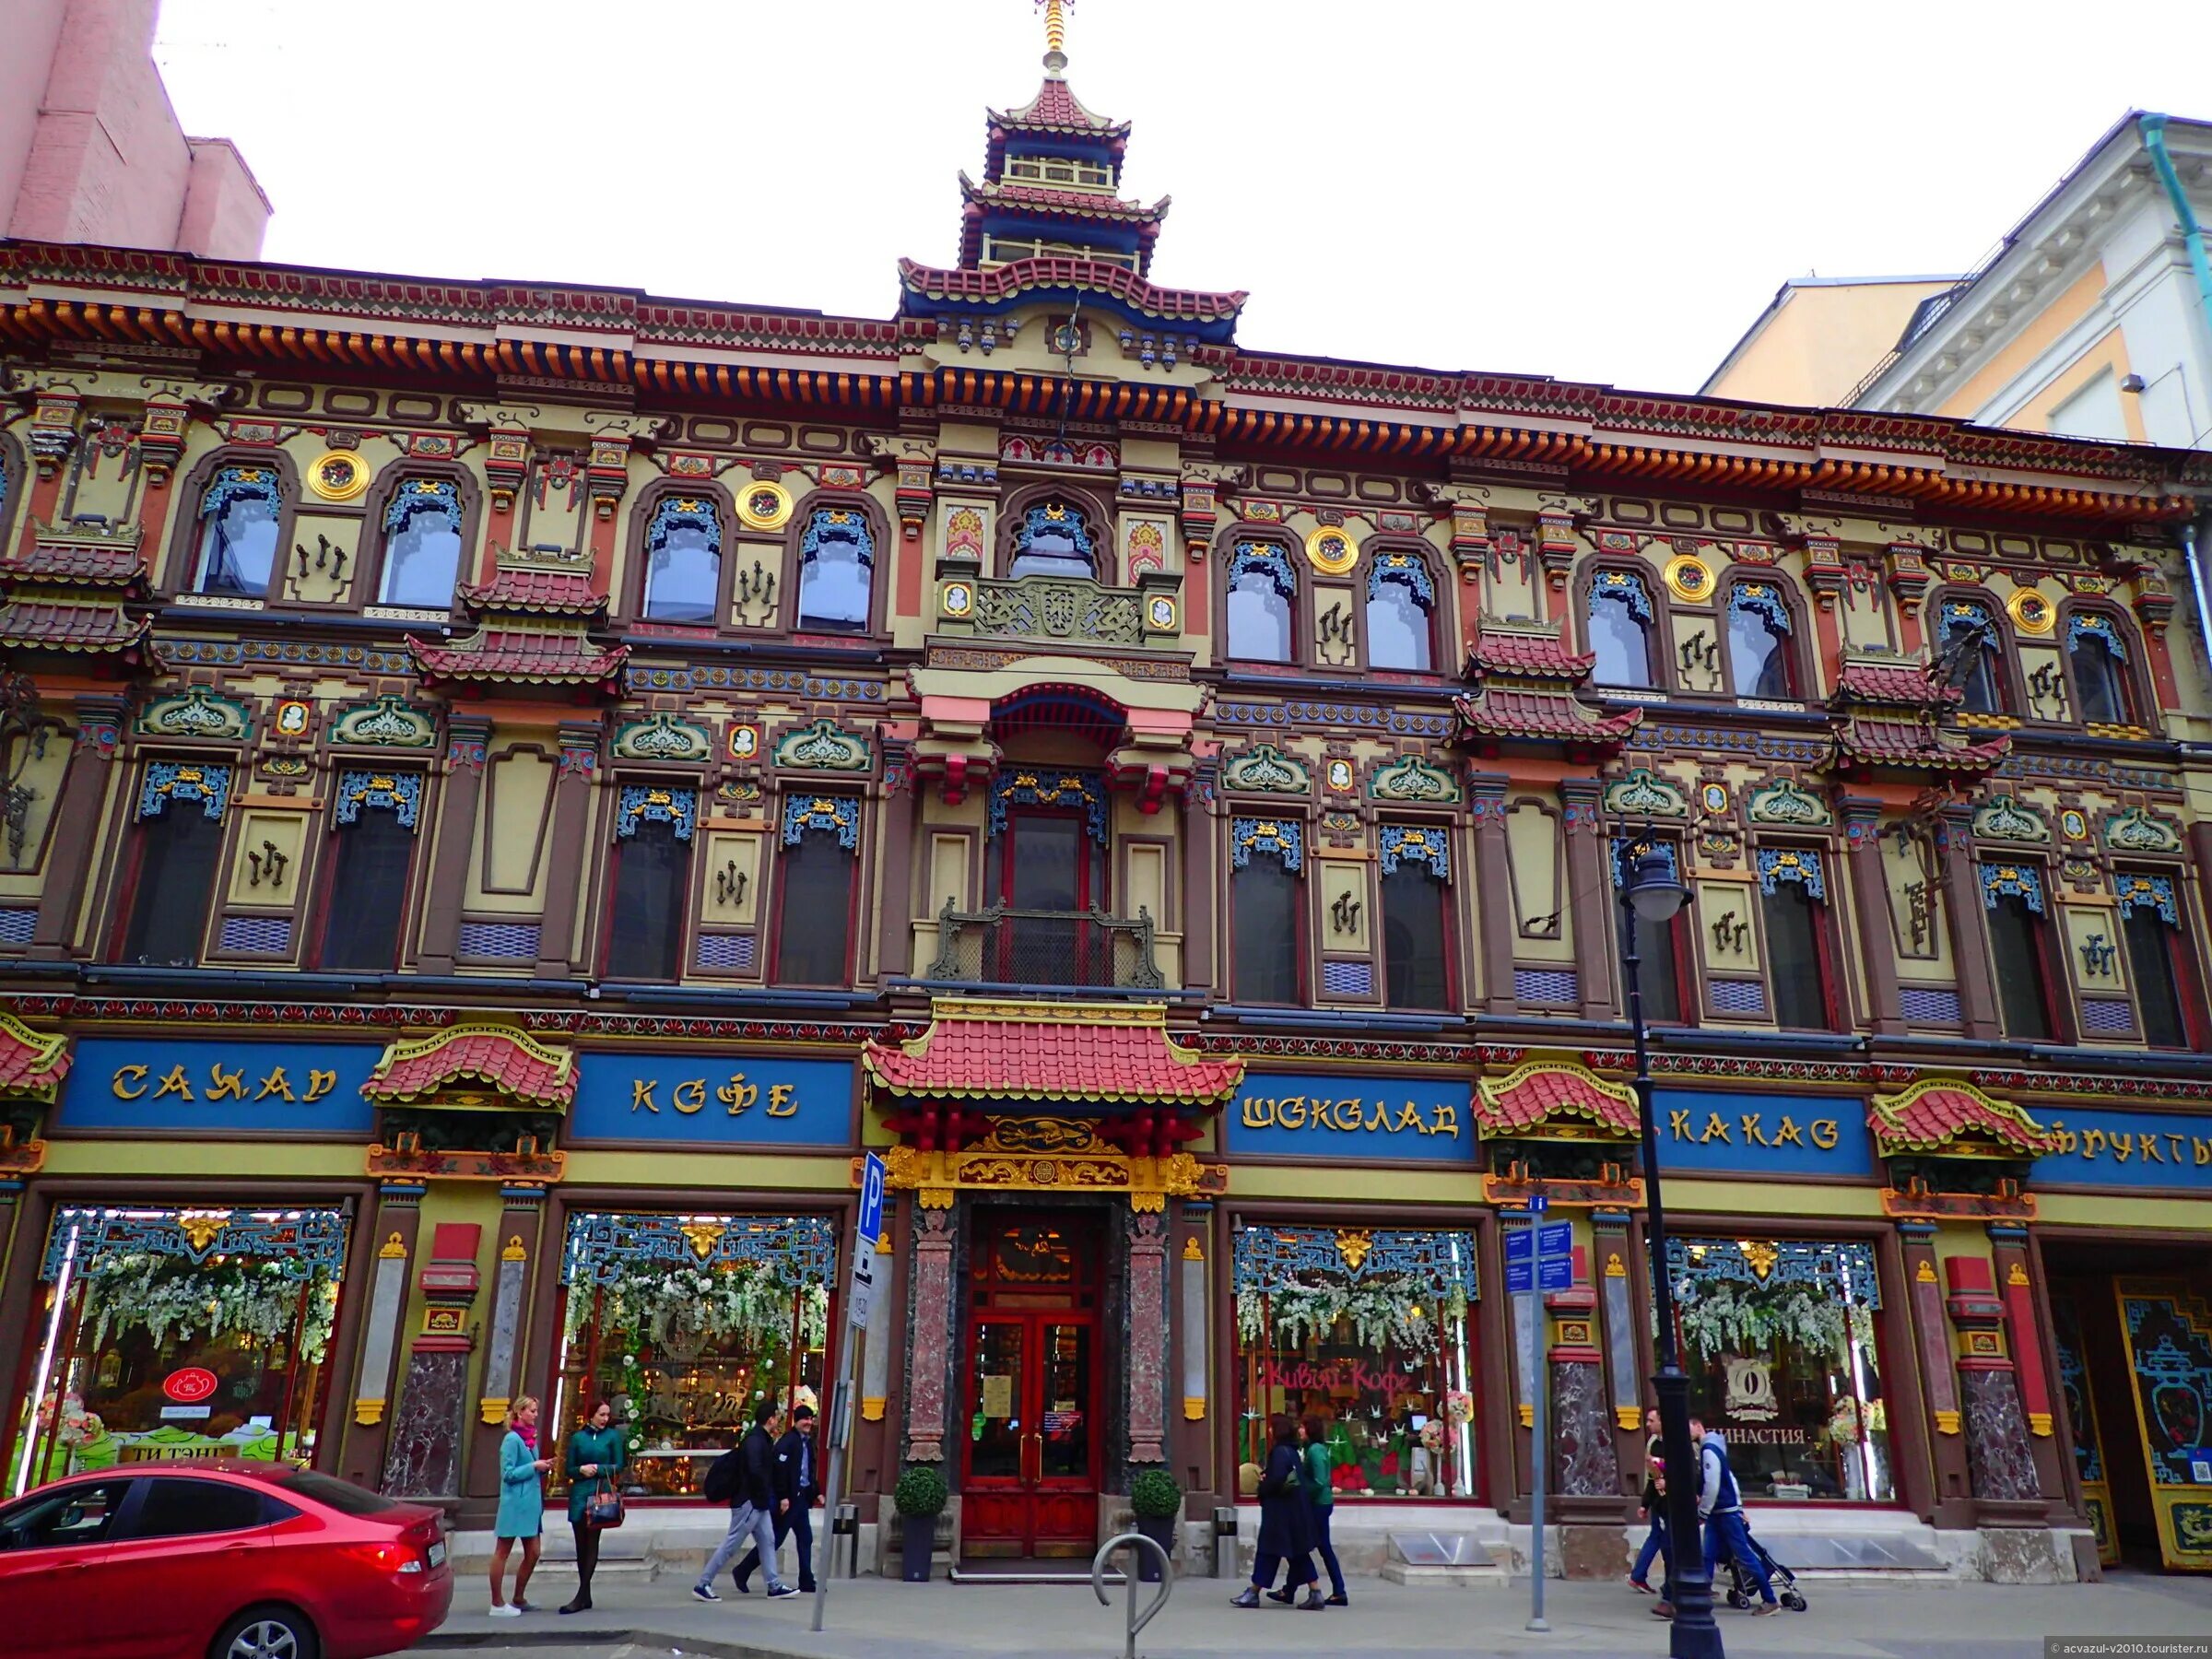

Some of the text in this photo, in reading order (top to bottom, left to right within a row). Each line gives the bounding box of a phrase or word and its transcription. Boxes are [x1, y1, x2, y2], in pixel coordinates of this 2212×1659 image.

[112, 1063, 336, 1102] САХАР
[631, 1072, 798, 1118] КОФЕ
[1241, 1096, 1459, 1141] ШОКОЛАД
[1669, 1109, 1839, 1149] КАКАО
[865, 1165, 880, 1228] P
[1706, 1428, 1806, 1444] ИНАСТИЯ
